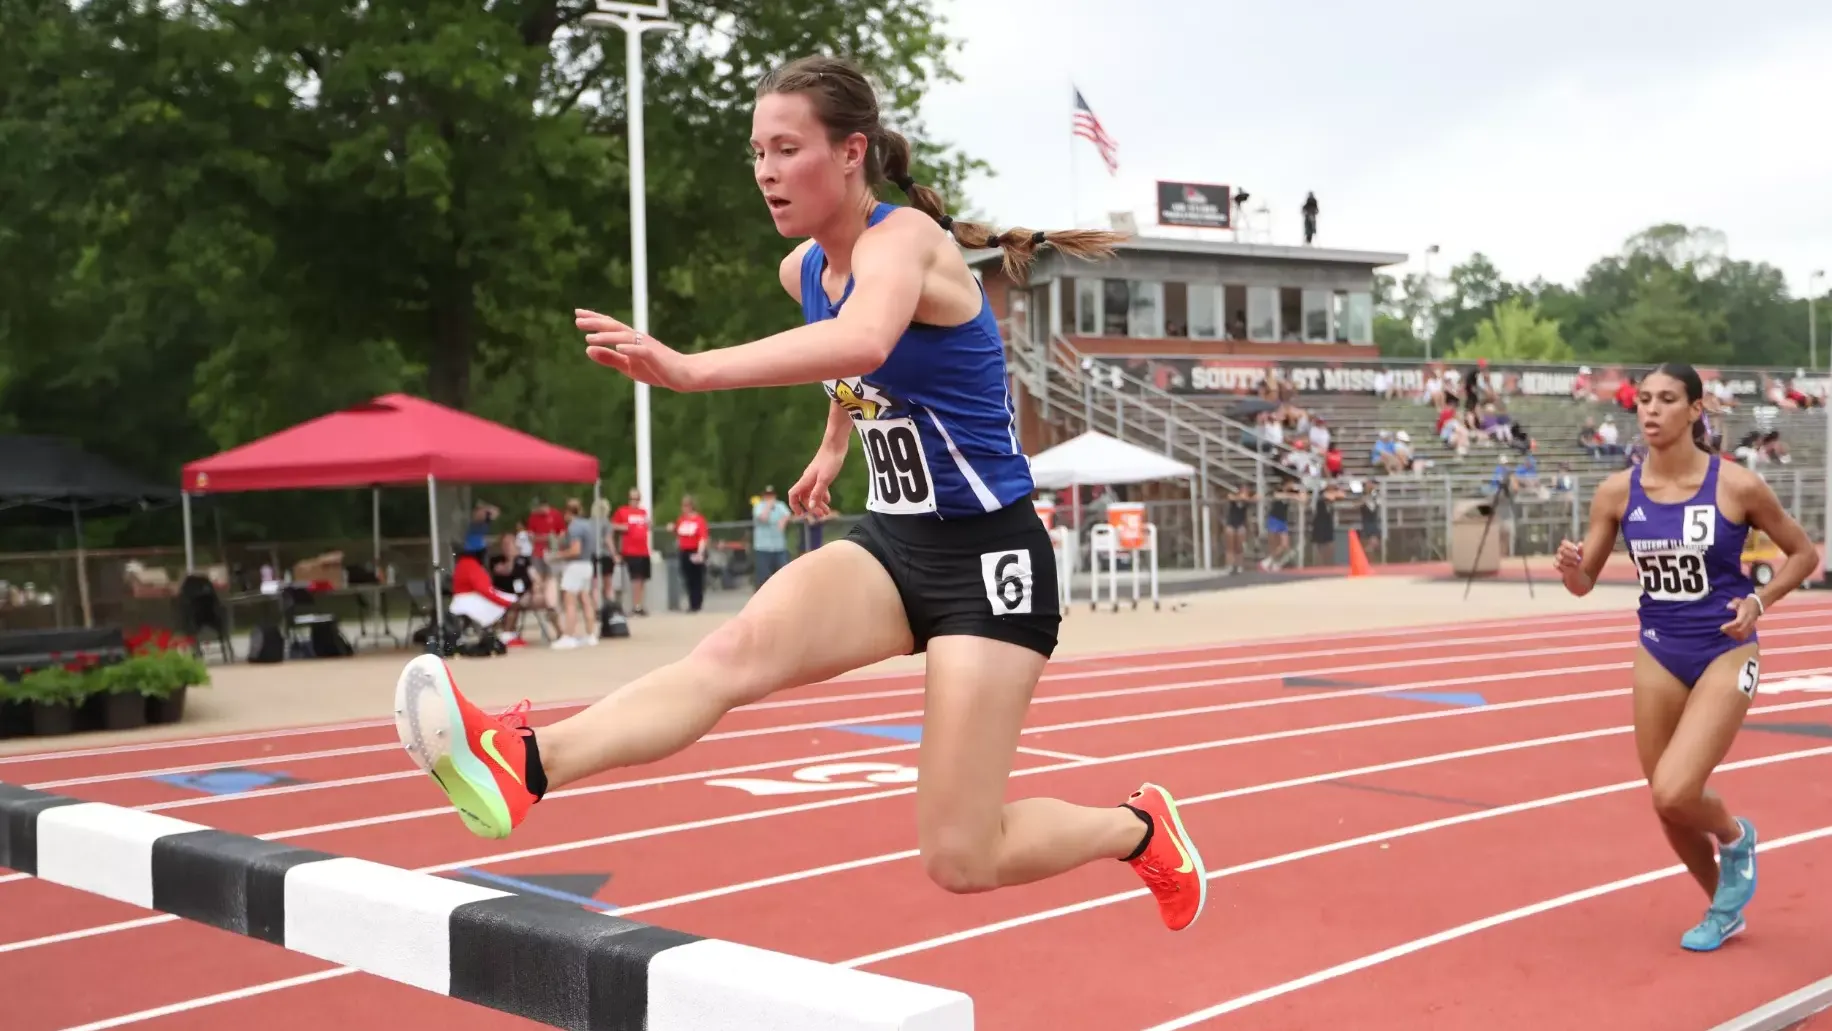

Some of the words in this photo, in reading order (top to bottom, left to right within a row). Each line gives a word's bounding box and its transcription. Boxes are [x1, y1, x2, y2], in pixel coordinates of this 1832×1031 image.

[1191, 367, 1320, 390] SOUTHST
[1691, 509, 1708, 542] 5
[994, 553, 1024, 610] 6
[1637, 555, 1704, 594] 553
[1744, 660, 1756, 692] 5
